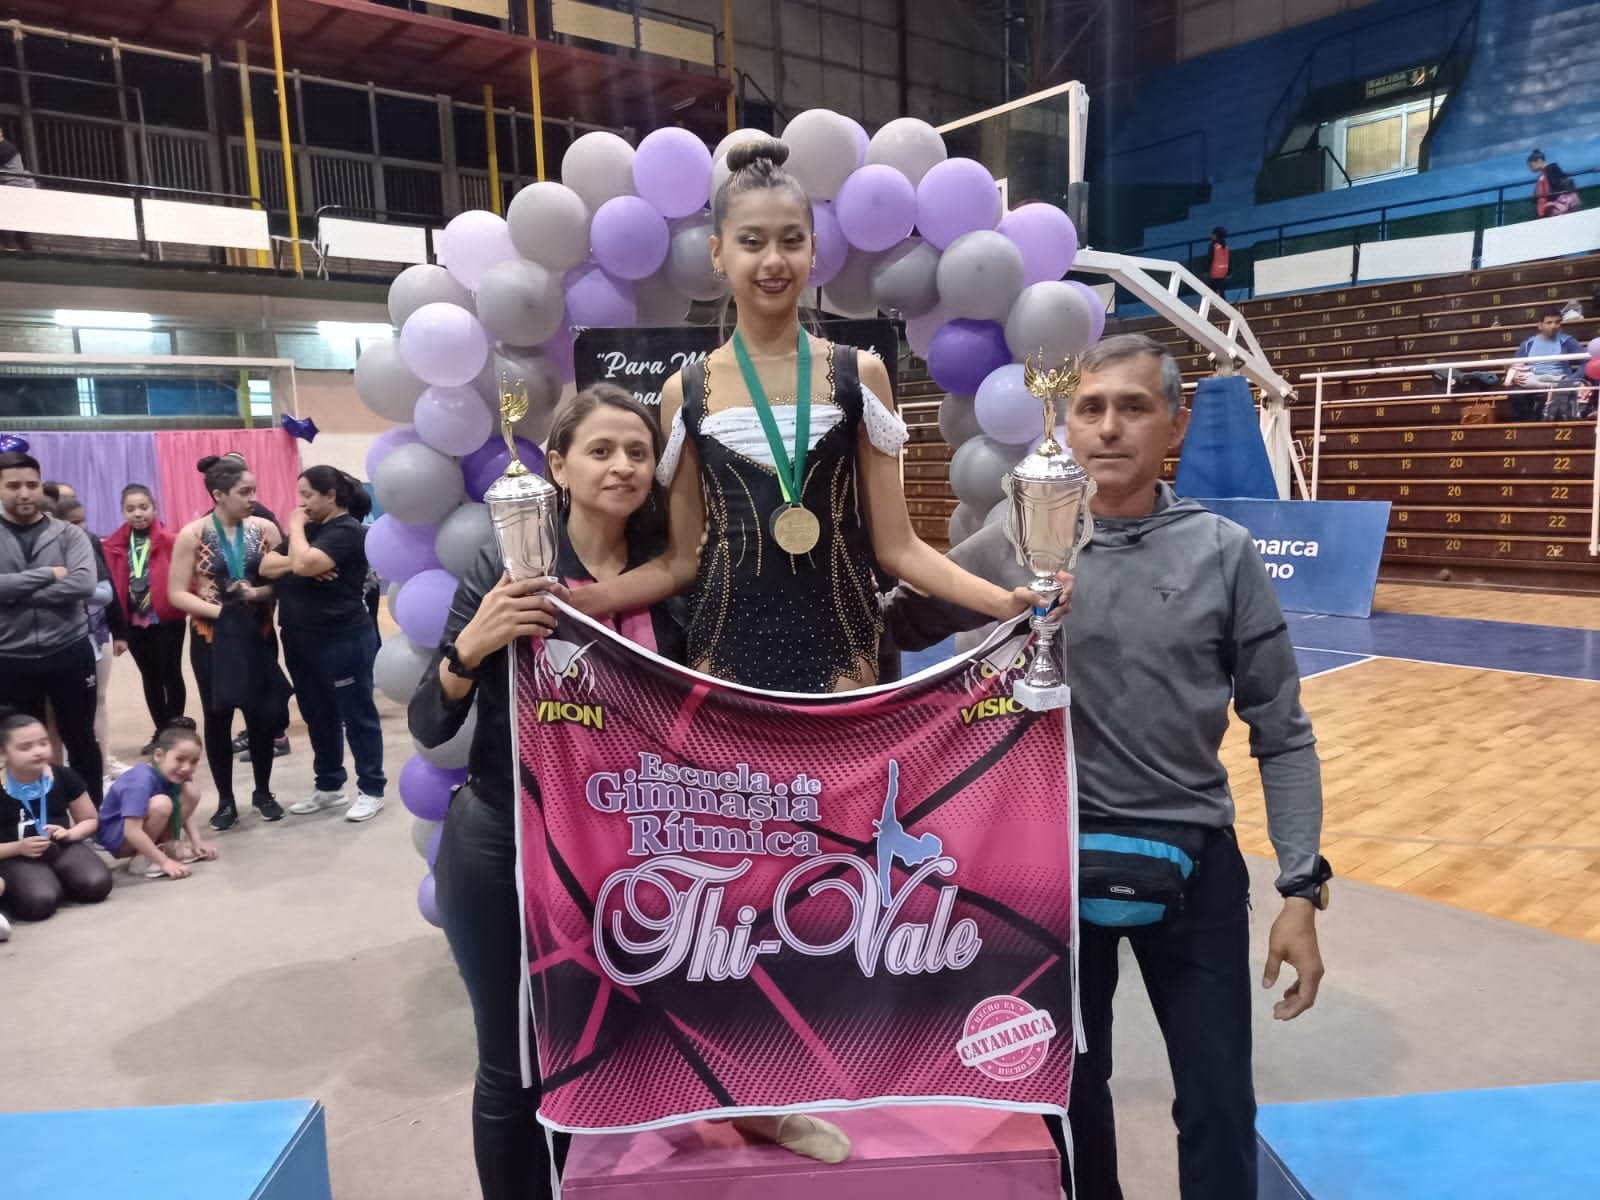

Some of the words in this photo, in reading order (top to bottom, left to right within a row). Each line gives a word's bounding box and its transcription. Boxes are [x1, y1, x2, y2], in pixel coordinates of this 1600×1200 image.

[1403, 340, 1416, 351] 17
[1404, 431, 1415, 443] 19
[1450, 430, 1465, 441] 20
[1504, 429, 1517, 441] 21
[1554, 428, 1573, 441] 22
[1449, 457, 1464, 468] 20
[1503, 456, 1516, 468] 21
[1552, 457, 1571, 470] 22
[1447, 485, 1462, 497] 20
[1501, 486, 1513, 497] 21
[1551, 486, 1569, 499] 22
[1398, 512, 1408, 522] 19
[1445, 512, 1461, 524] 20
[1500, 513, 1512, 524] 21
[1548, 515, 1567, 528] 22
[1396, 538, 1408, 549] 19
[1445, 539, 1461, 551] 20
[1499, 541, 1512, 553] 21
[1545, 544, 1564, 557] 22
[960, 697, 1025, 724] VISIO
[638, 752, 772, 794] Escuela
[791, 773, 822, 795] de
[586, 769, 822, 822] Gimnasia
[627, 811, 822, 857] Rítmica
[593, 854, 982, 986] Thi-Vale
[960, 1016, 1054, 1061] CATAMARCA
